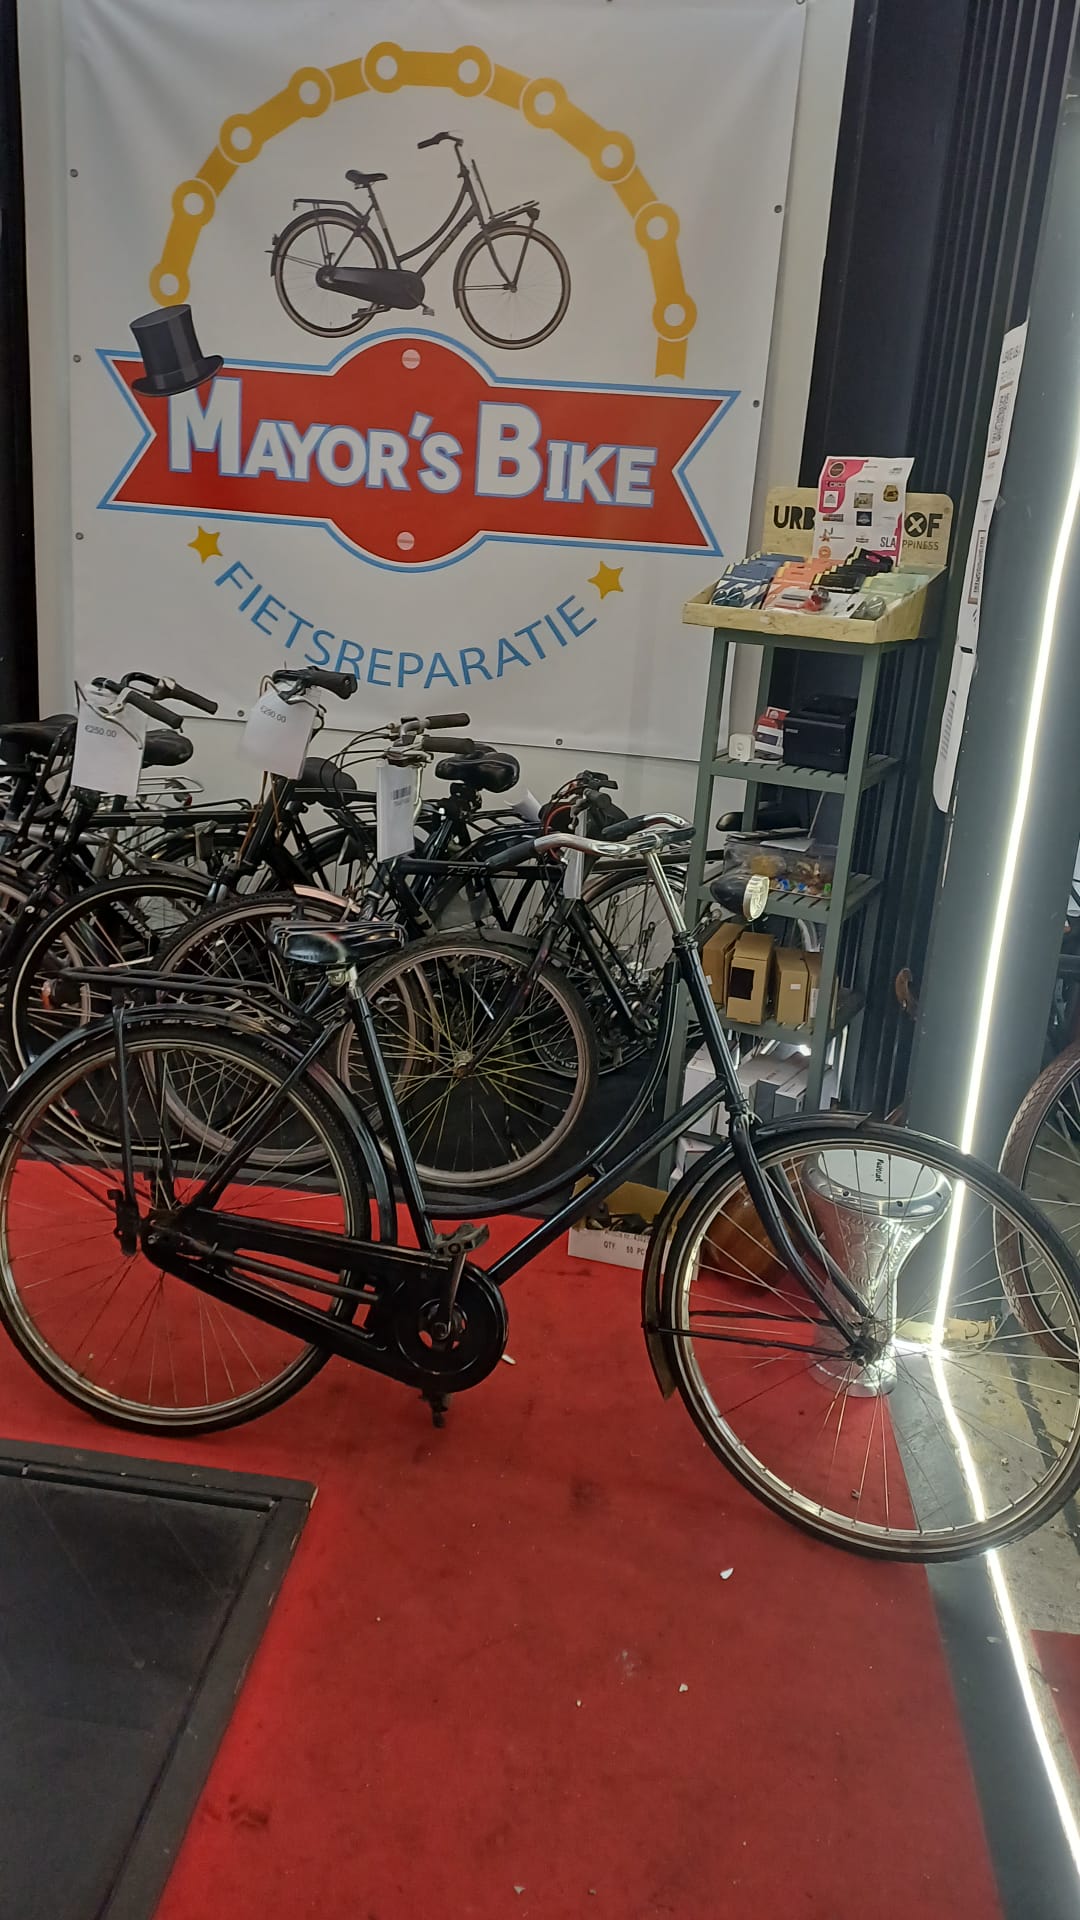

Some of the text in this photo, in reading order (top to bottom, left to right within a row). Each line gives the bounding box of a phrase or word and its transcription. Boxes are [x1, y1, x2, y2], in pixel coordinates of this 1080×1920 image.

[168, 377, 658, 507] MAYOR'S BIKE
[902, 540, 939, 551] PPINESS
[214, 561, 598, 689] FIETSREPARATIE
[85, 725, 117, 738] €250.00
